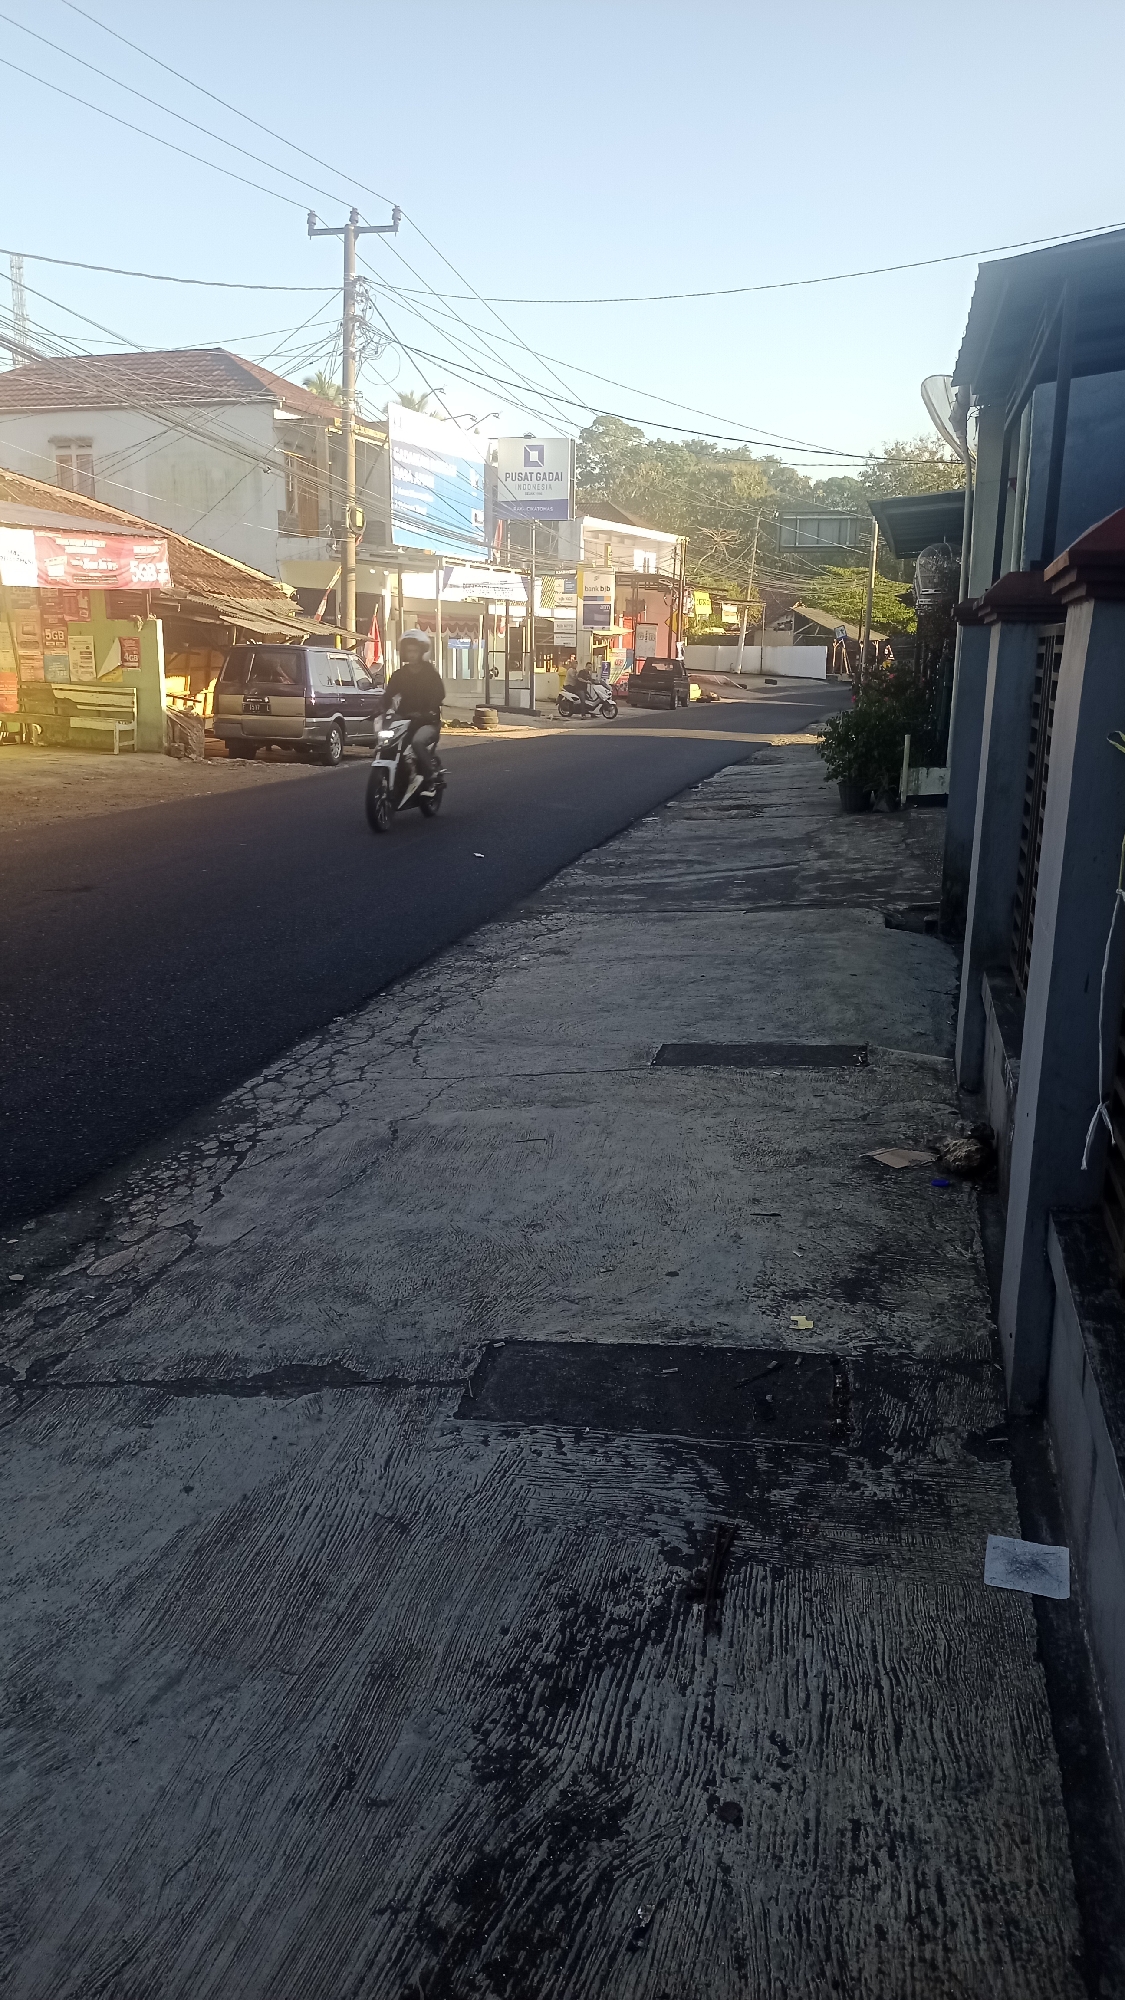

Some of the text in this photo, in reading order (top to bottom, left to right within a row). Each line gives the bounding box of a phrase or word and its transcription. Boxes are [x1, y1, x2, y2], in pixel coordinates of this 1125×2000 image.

[505, 472, 563, 482] PUSAT GADAI
[130, 560, 158, 583] 5GB
[600, 585, 611, 593] bjb
[45, 628, 65, 640] 5GB
[123, 651, 139, 662] 4GB
